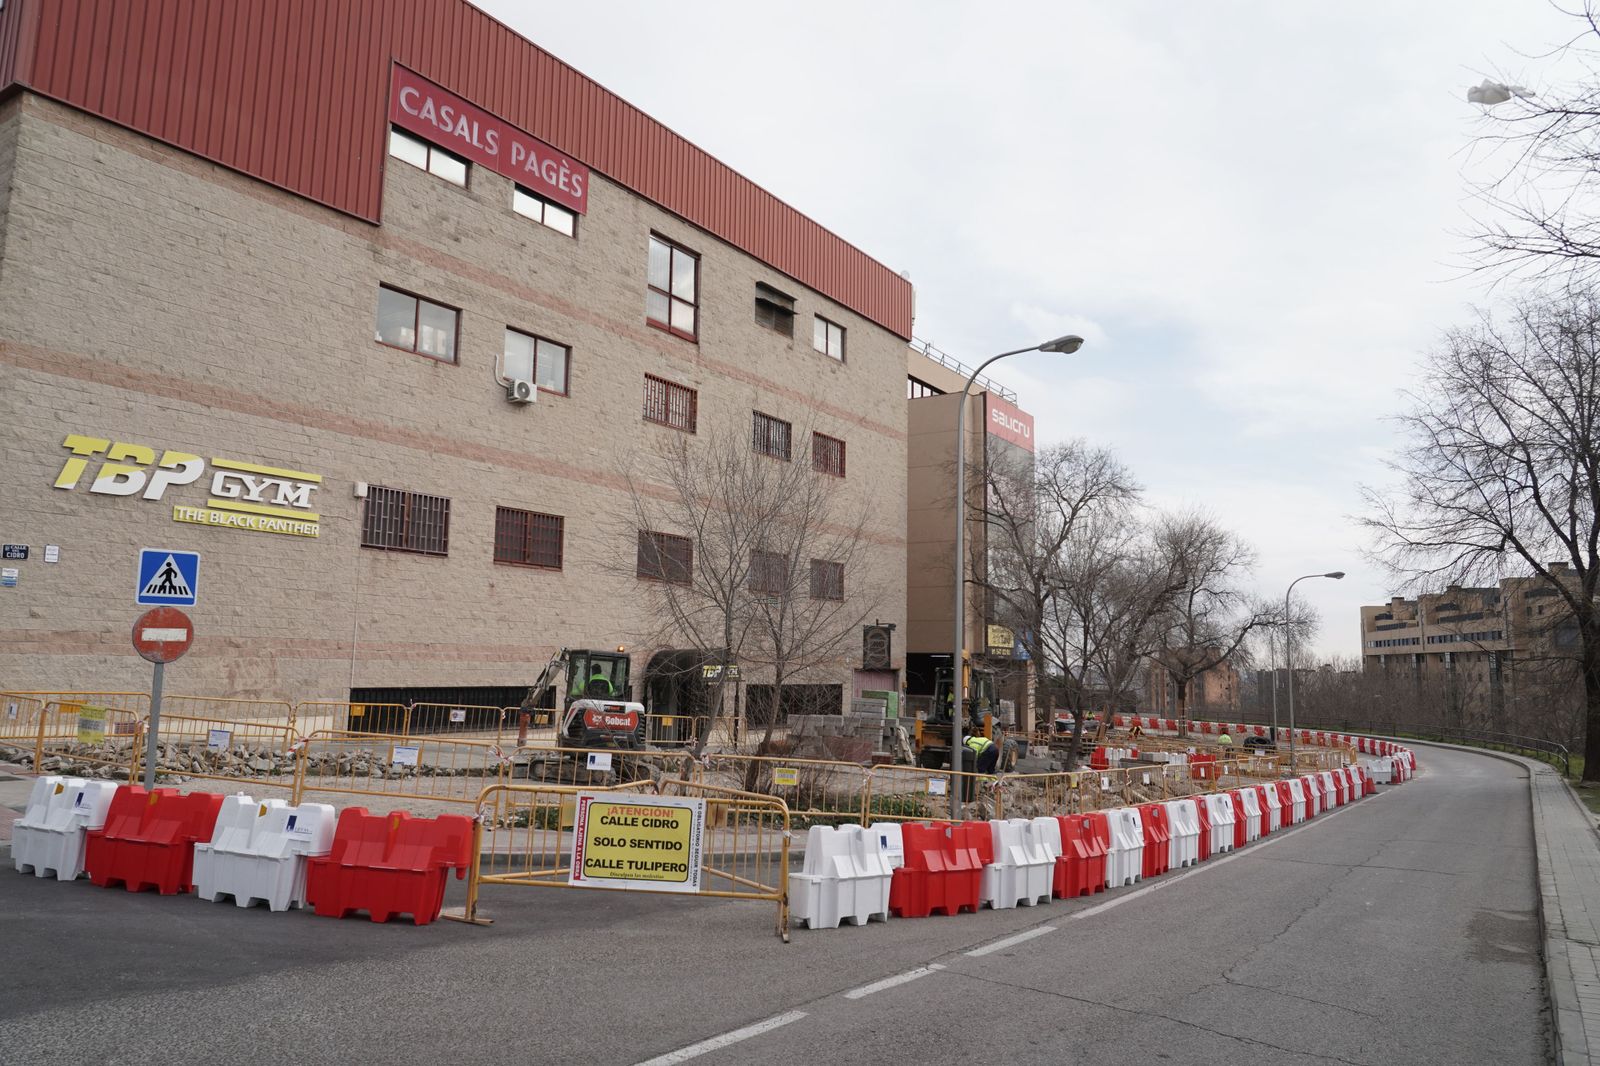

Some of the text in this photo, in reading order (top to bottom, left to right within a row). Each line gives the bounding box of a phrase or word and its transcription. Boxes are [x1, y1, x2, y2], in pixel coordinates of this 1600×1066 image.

[399, 86, 582, 198] CASALS PAGÈS
[53, 434, 318, 508] TBP GYM
[176, 506, 320, 535] THE BLACK PANTHER
[604, 715, 631, 726] Bobcat
[607, 805, 674, 818] ¡ATENCIÓN!
[600, 816, 679, 829] CALLE CIDRO
[593, 837, 682, 851] SOLO SENTIDO
[576, 852, 582, 860] LA
[585, 858, 687, 873] CALLE TULIPERO
